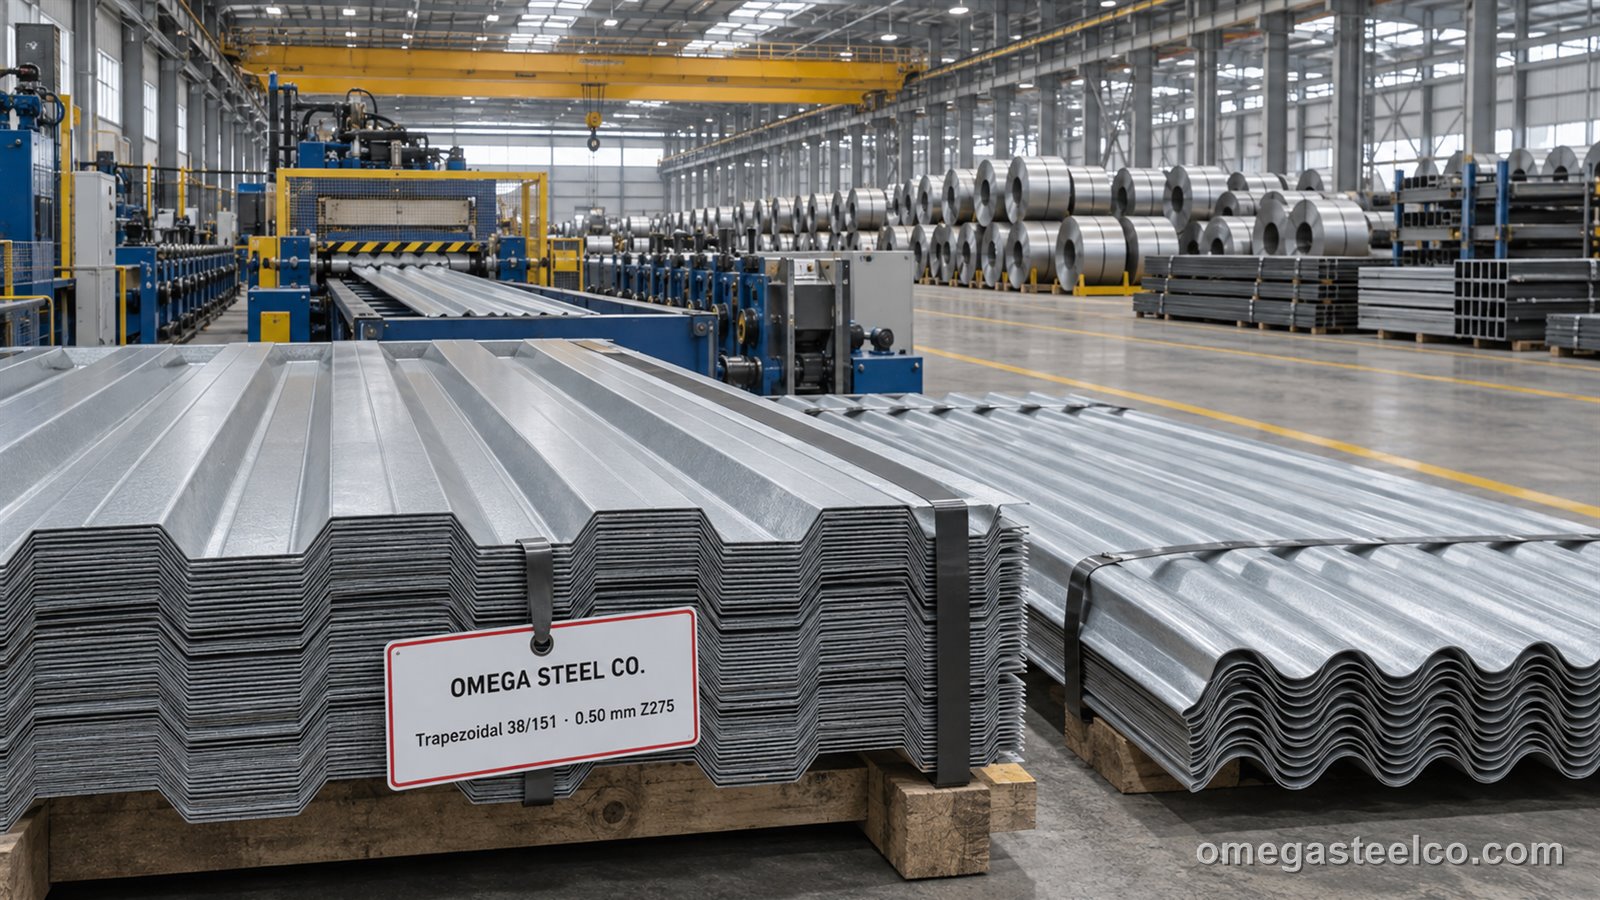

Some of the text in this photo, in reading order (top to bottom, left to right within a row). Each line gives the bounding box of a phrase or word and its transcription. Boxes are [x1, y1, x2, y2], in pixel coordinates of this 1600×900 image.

[450, 655, 646, 698] OMEGA STEEL CO.
[415, 721, 503, 748] Trapezoidal
[507, 714, 557, 735] 38/151
[575, 707, 606, 725] 0.50
[610, 706, 637, 721] mm
[640, 698, 675, 717] Z275
